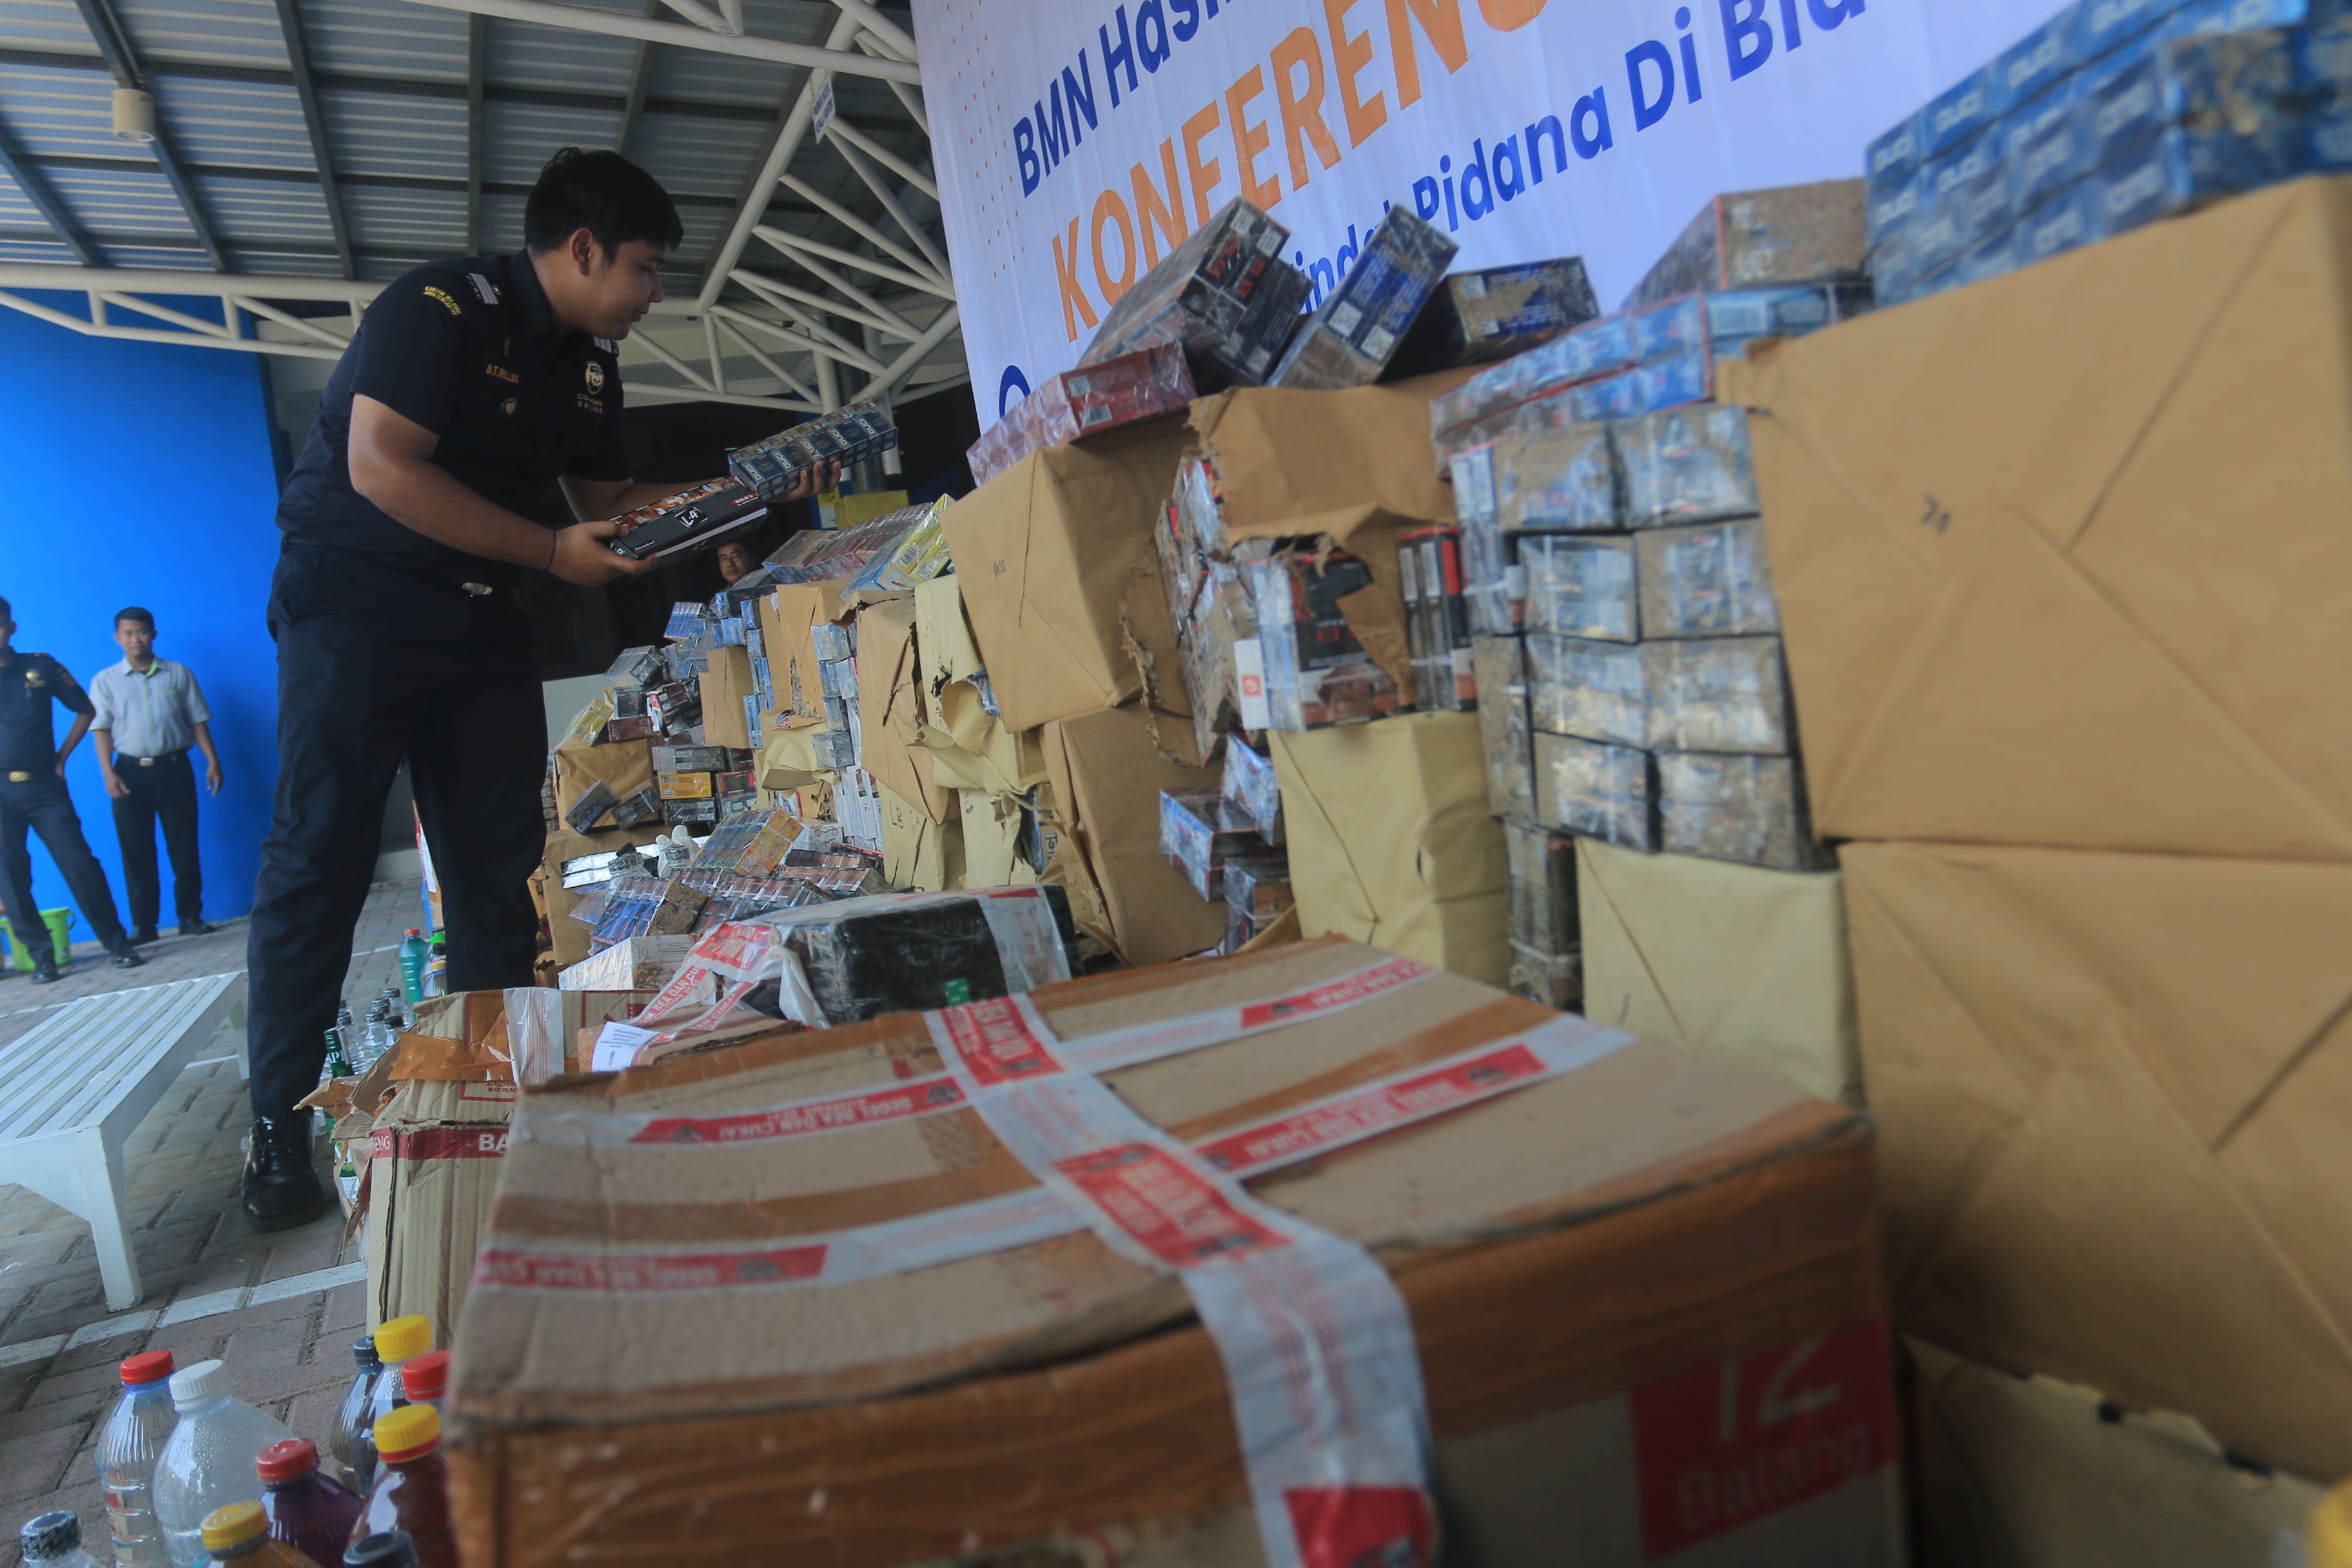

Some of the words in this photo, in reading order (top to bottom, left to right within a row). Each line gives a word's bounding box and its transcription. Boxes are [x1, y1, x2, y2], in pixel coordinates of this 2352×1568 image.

[1013, 48, 1098, 198] BMN
[1099, 0, 1231, 109] Has
[1413, 86, 1613, 232] Pidana
[1625, 6, 1702, 133] Di
[1052, 0, 1547, 343] KONFEREN
[858, 418, 876, 435] GUCI
[831, 429, 848, 446] GUCI
[774, 453, 792, 469] GUCI
[746, 464, 762, 481] GUCI
[653, 995, 672, 1012] BEA
[669, 978, 688, 997] DAN
[822, 1108, 856, 1128] BEA
[863, 1097, 912, 1119] SEGEL
[719, 1122, 776, 1141] CUKAI
[779, 1114, 817, 1134] DAN
[373, 1135, 391, 1151] ENG
[1678, 1421, 1867, 1532] Batang
